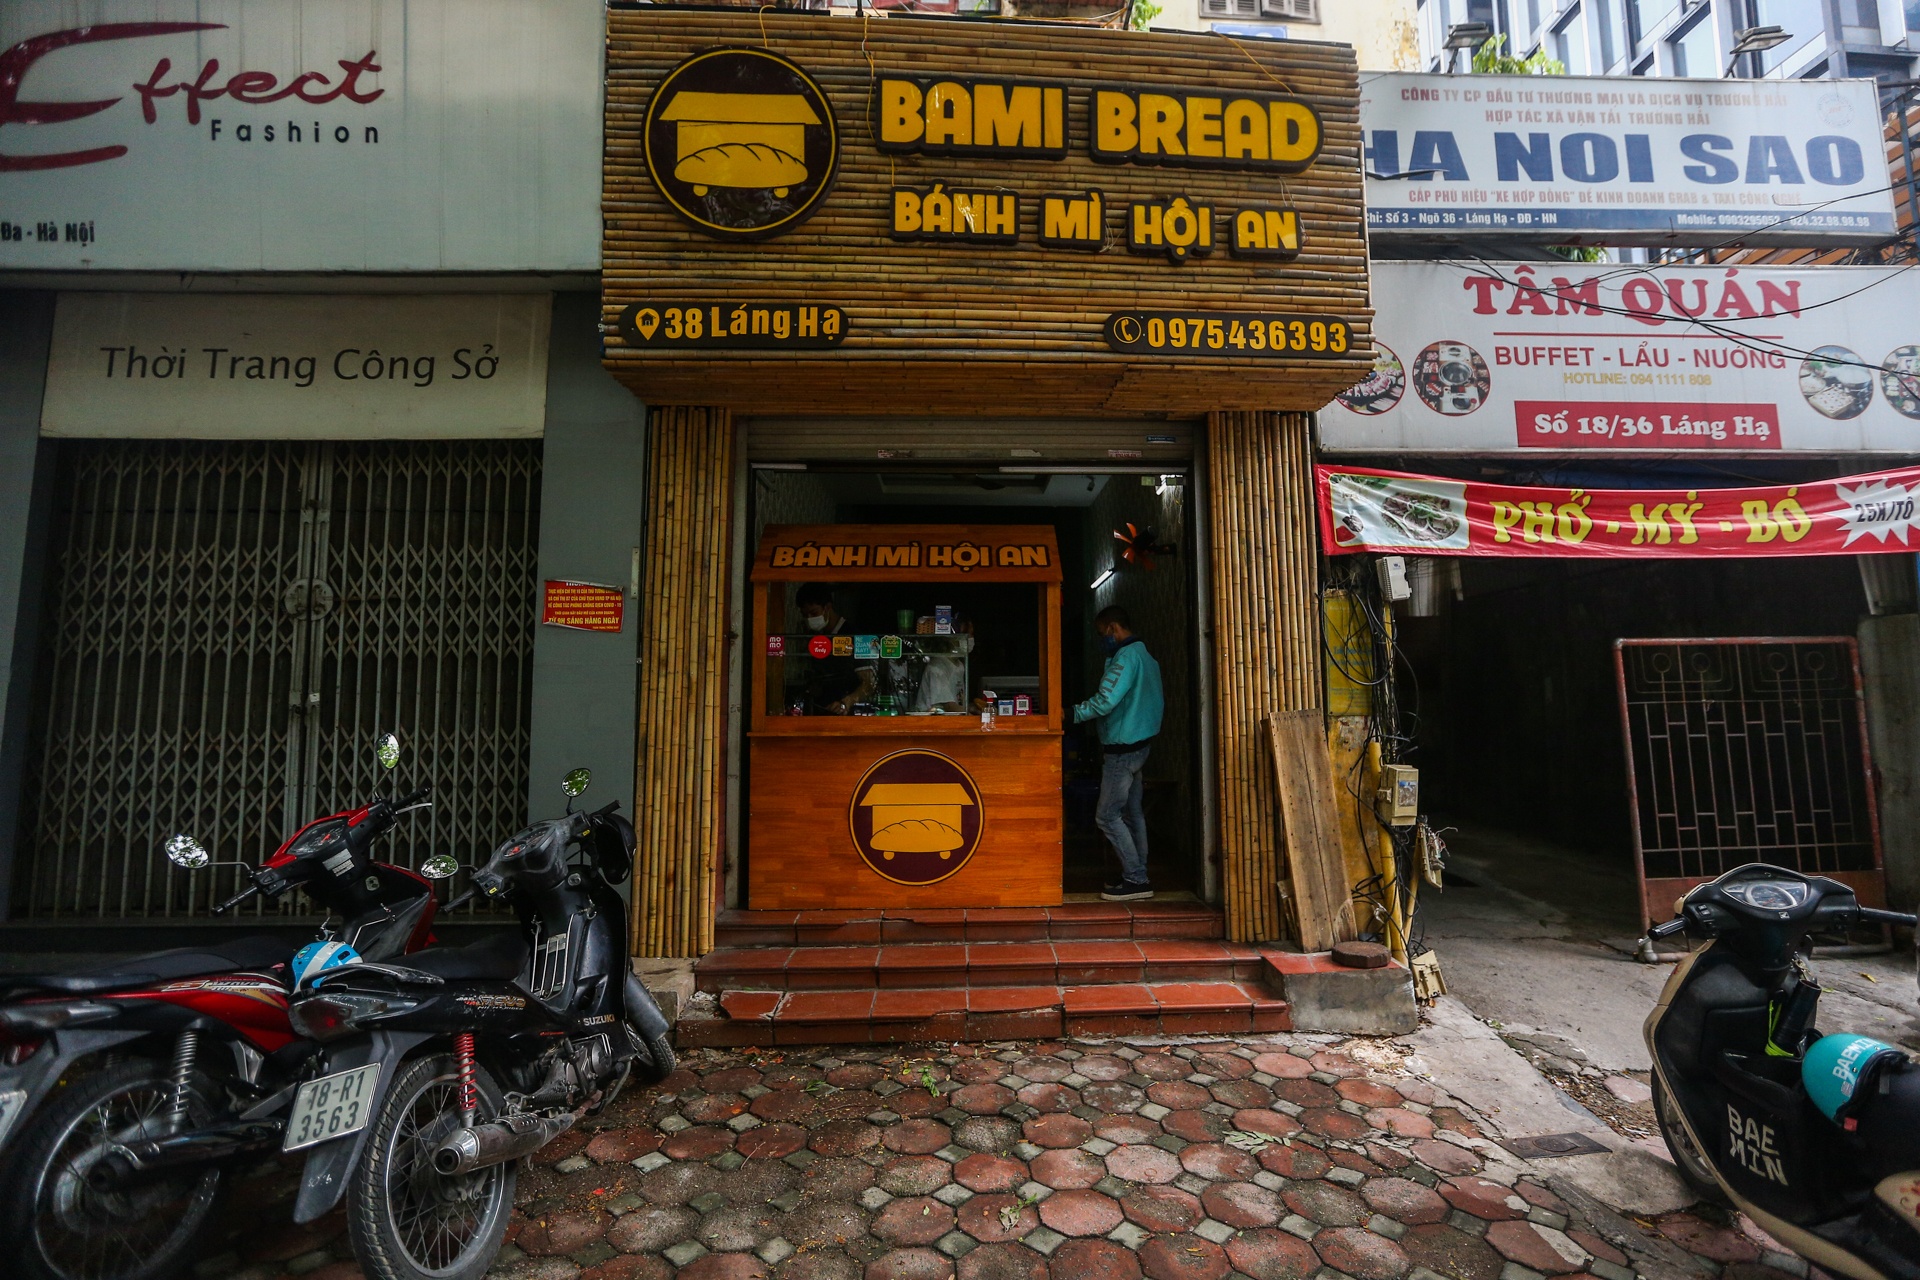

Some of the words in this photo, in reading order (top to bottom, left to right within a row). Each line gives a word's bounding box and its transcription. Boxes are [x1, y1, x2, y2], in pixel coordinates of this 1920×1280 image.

[0, 22, 385, 171] Effect
[1443, 89, 1459, 102] TY
[1463, 90, 1482, 102] CP
[210, 119, 380, 144] Fashion
[882, 79, 1063, 148] BAMI
[1097, 91, 1319, 161] BREAD
[1494, 132, 1655, 183] NOI
[1680, 133, 1867, 187] SAO
[37, 221, 58, 242] Hà
[65, 221, 95, 247] Nội
[895, 183, 1015, 234] BÁNH
[1045, 192, 1100, 240] MÌ
[1133, 197, 1210, 256] HỘI
[1237, 210, 1298, 249] AN
[1402, 213, 1409, 224] 3
[1443, 213, 1456, 225] 36
[1466, 212, 1491, 226] Láng
[1494, 214, 1508, 227] Hạ
[1542, 213, 1557, 224] HN
[1676, 213, 1717, 226] Mobile:
[1463, 264, 1604, 316] TÂM
[1621, 268, 1802, 327] QUÁN
[665, 307, 703, 339] 38
[711, 303, 791, 339] Láng
[798, 307, 840, 341] Hạ
[1147, 317, 1347, 353] 0975436393
[100, 347, 187, 380] Thời
[201, 348, 317, 387] Trang
[333, 347, 435, 387] Công
[451, 344, 499, 380] Sở
[1495, 346, 1595, 367] BUFFET
[1619, 340, 1670, 368] LẨU
[1563, 372, 1628, 385] HOTLINE:
[1630, 373, 1654, 386] 094
[1656, 374, 1685, 386] 1111
[1534, 409, 1569, 435] Số
[1577, 415, 1654, 439] 18/36
[1661, 414, 1727, 440] Láng
[1733, 416, 1771, 438] Hạ
[772, 542, 867, 567] BÁNH
[875, 542, 920, 567] MÌ
[929, 542, 990, 571] HỘI
[999, 546, 1048, 567] AN
[583, 1013, 615, 1027] SUZUKI
[297, 1101, 360, 1143] 3563
[1727, 1103, 1780, 1155] BAE
[1730, 1132, 1789, 1187] MIN
